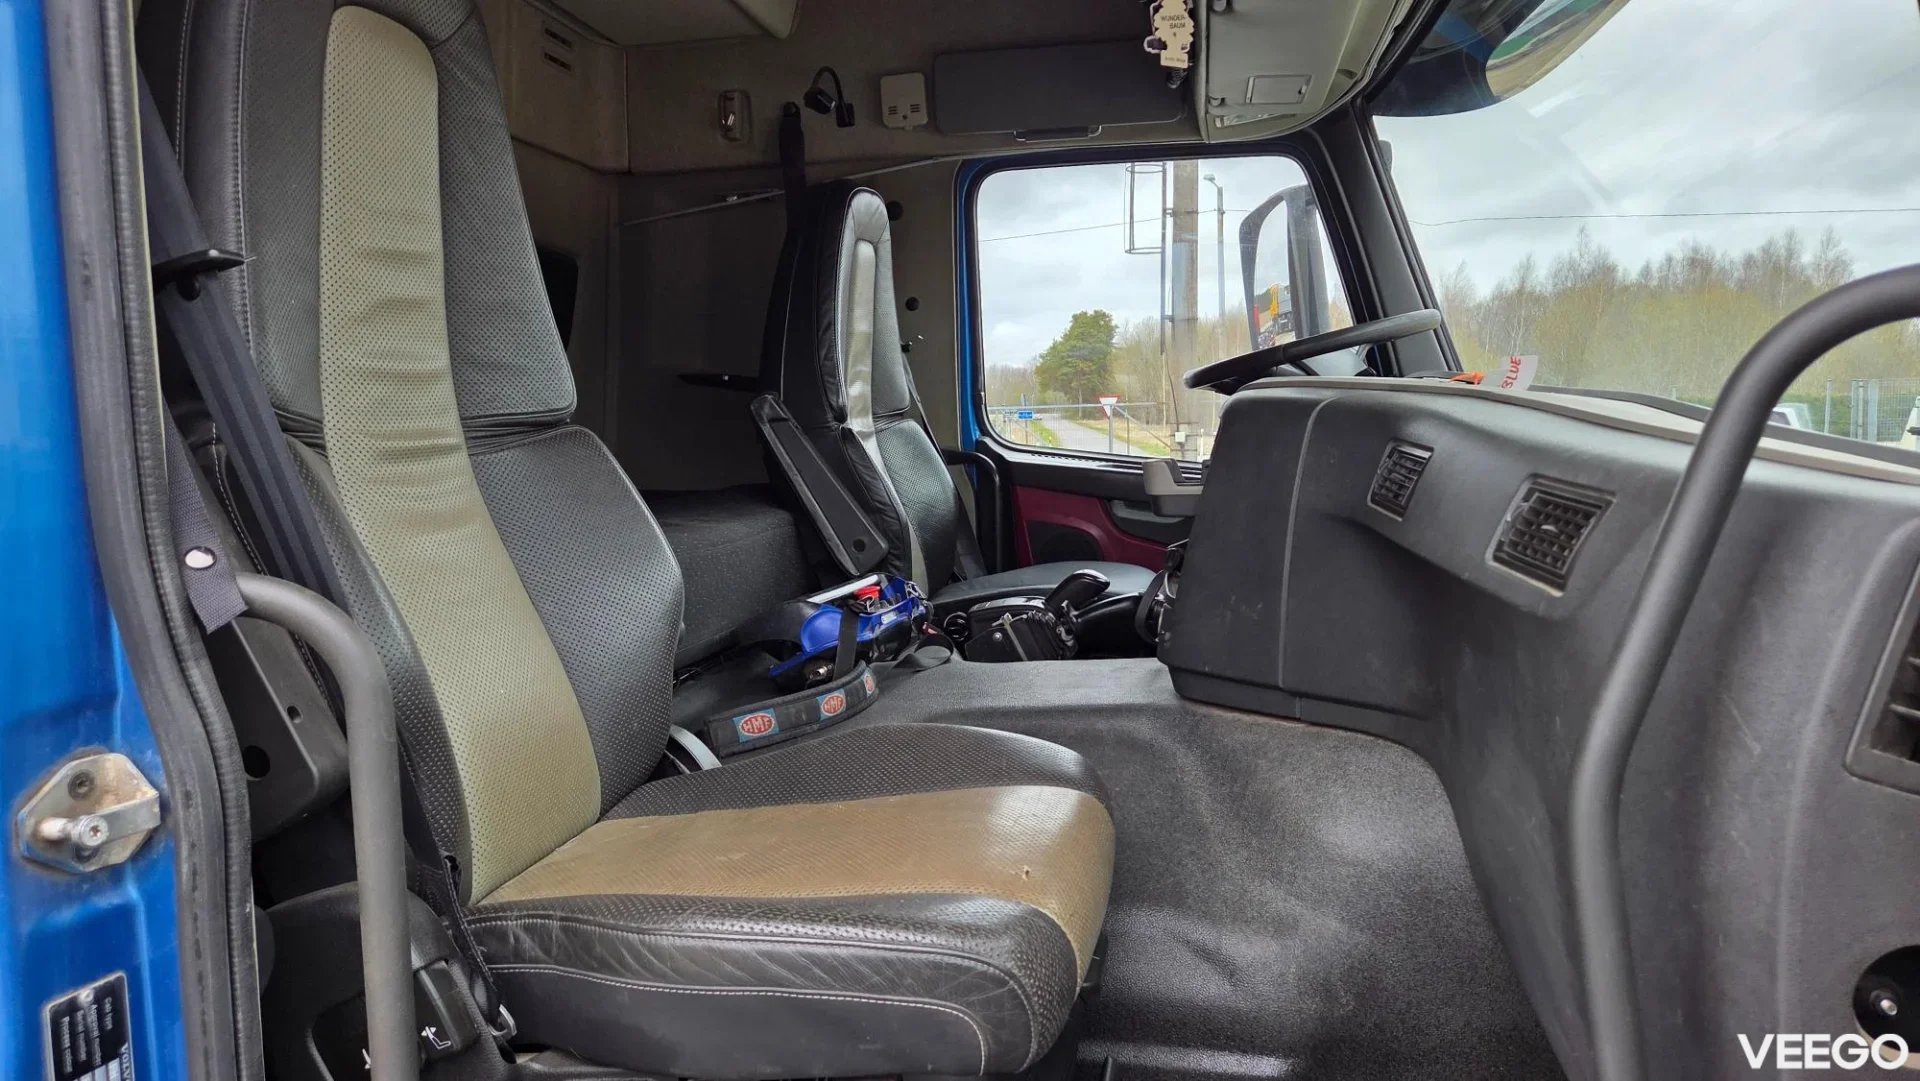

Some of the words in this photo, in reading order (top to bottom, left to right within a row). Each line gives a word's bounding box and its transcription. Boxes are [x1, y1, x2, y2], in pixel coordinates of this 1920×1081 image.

[824, 696, 844, 713] HMF
[743, 715, 772, 733] HMF
[104, 996, 113, 1012] Cab
[89, 1004, 101, 1037] Approval
[105, 1013, 114, 1030] type
